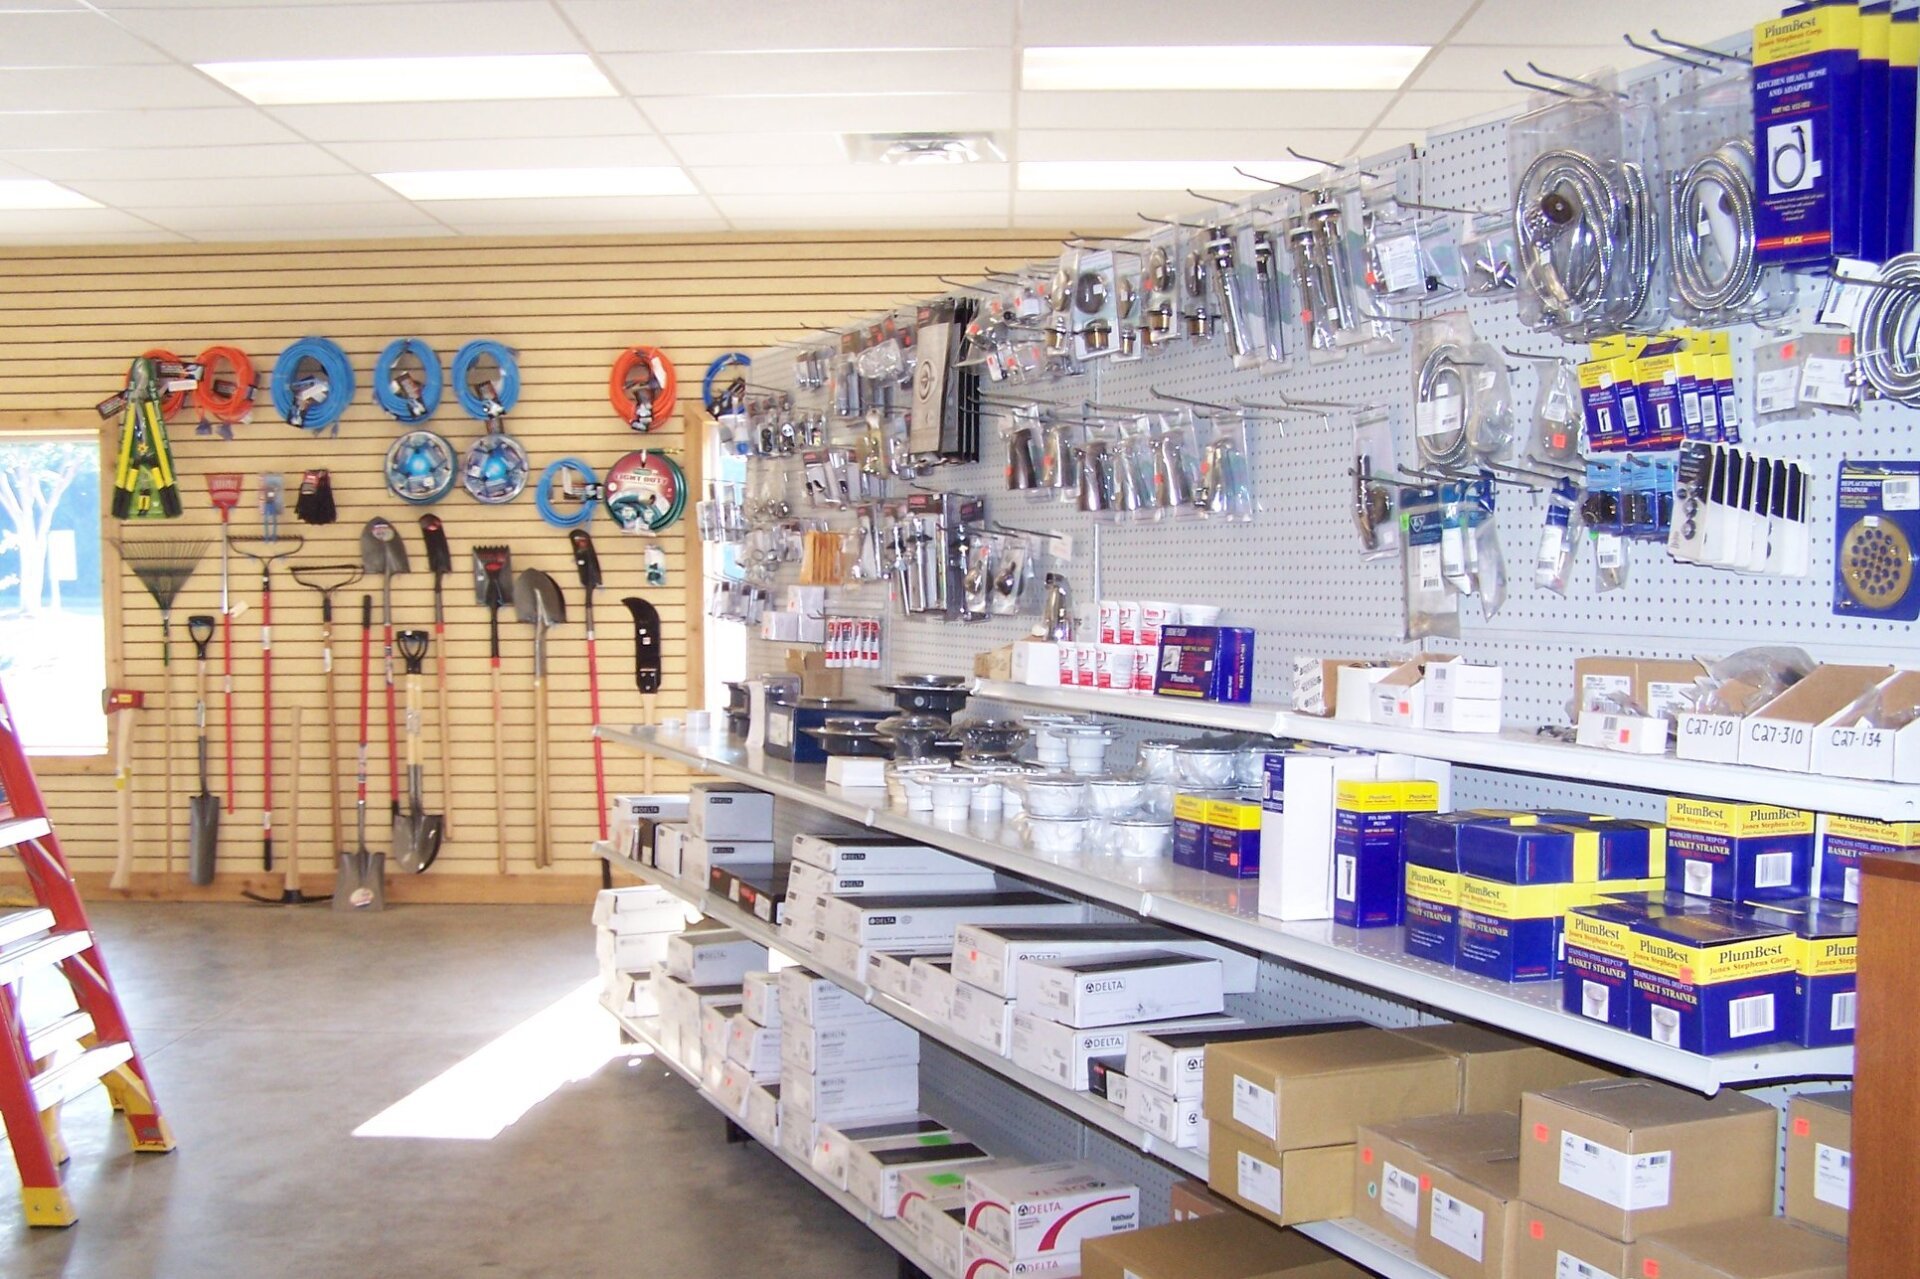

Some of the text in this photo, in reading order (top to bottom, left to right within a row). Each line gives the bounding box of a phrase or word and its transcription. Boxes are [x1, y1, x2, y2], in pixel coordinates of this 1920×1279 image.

[1765, 17, 1816, 38] PlumBest
[1756, 77, 1785, 90] KITCHEN
[1807, 67, 1827, 79] HOSE
[1768, 81, 1814, 98] AND ADAPTER
[1685, 717, 1733, 736] C27-150
[1751, 723, 1803, 745] C27-310
[1831, 729, 1882, 748] C27-134
[1676, 803, 1723, 819] PlumBest
[1750, 808, 1801, 821] PlumBest
[1687, 816, 1712, 826] Stephens
[1714, 820, 1729, 829] Corp.
[1742, 820, 1807, 831] Jones Stephens Corp.
[1829, 821, 1847, 829] Jones
[1849, 823, 1879, 833] Stephens
[1838, 815, 1893, 827] PlumBe
[1669, 839, 1730, 856] BASKET STRAINER
[1827, 846, 1857, 858] BASKET
[1411, 870, 1446, 887] PlumBest
[1464, 882, 1500, 899] PlumBest
[1423, 910, 1452, 923] STRAINER
[1477, 923, 1509, 937] STRAINER
[1575, 918, 1619, 940] PlumBest
[1568, 929, 1625, 950] Jones Stephens Corp.
[1640, 939, 1689, 963] PlumBest
[1720, 944, 1782, 964] PlumBest
[1826, 944, 1857, 957] Plum
[1568, 956, 1626, 980] BASKET STRAINER
[1632, 951, 1678, 969] Jones Stephens
[1710, 966, 1730, 975] Jones
[1733, 960, 1768, 970] Stephens
[1770, 956, 1789, 966] Corp.
[1816, 957, 1857, 967] Jones Step
[1095, 980, 1123, 992] DELTA
[1633, 979, 1698, 1005] BASKET STRAINER
[1094, 1037, 1122, 1047] DELTA
[1028, 1201, 1062, 1214] DELTA
[1027, 1261, 1058, 1273] DELTA
